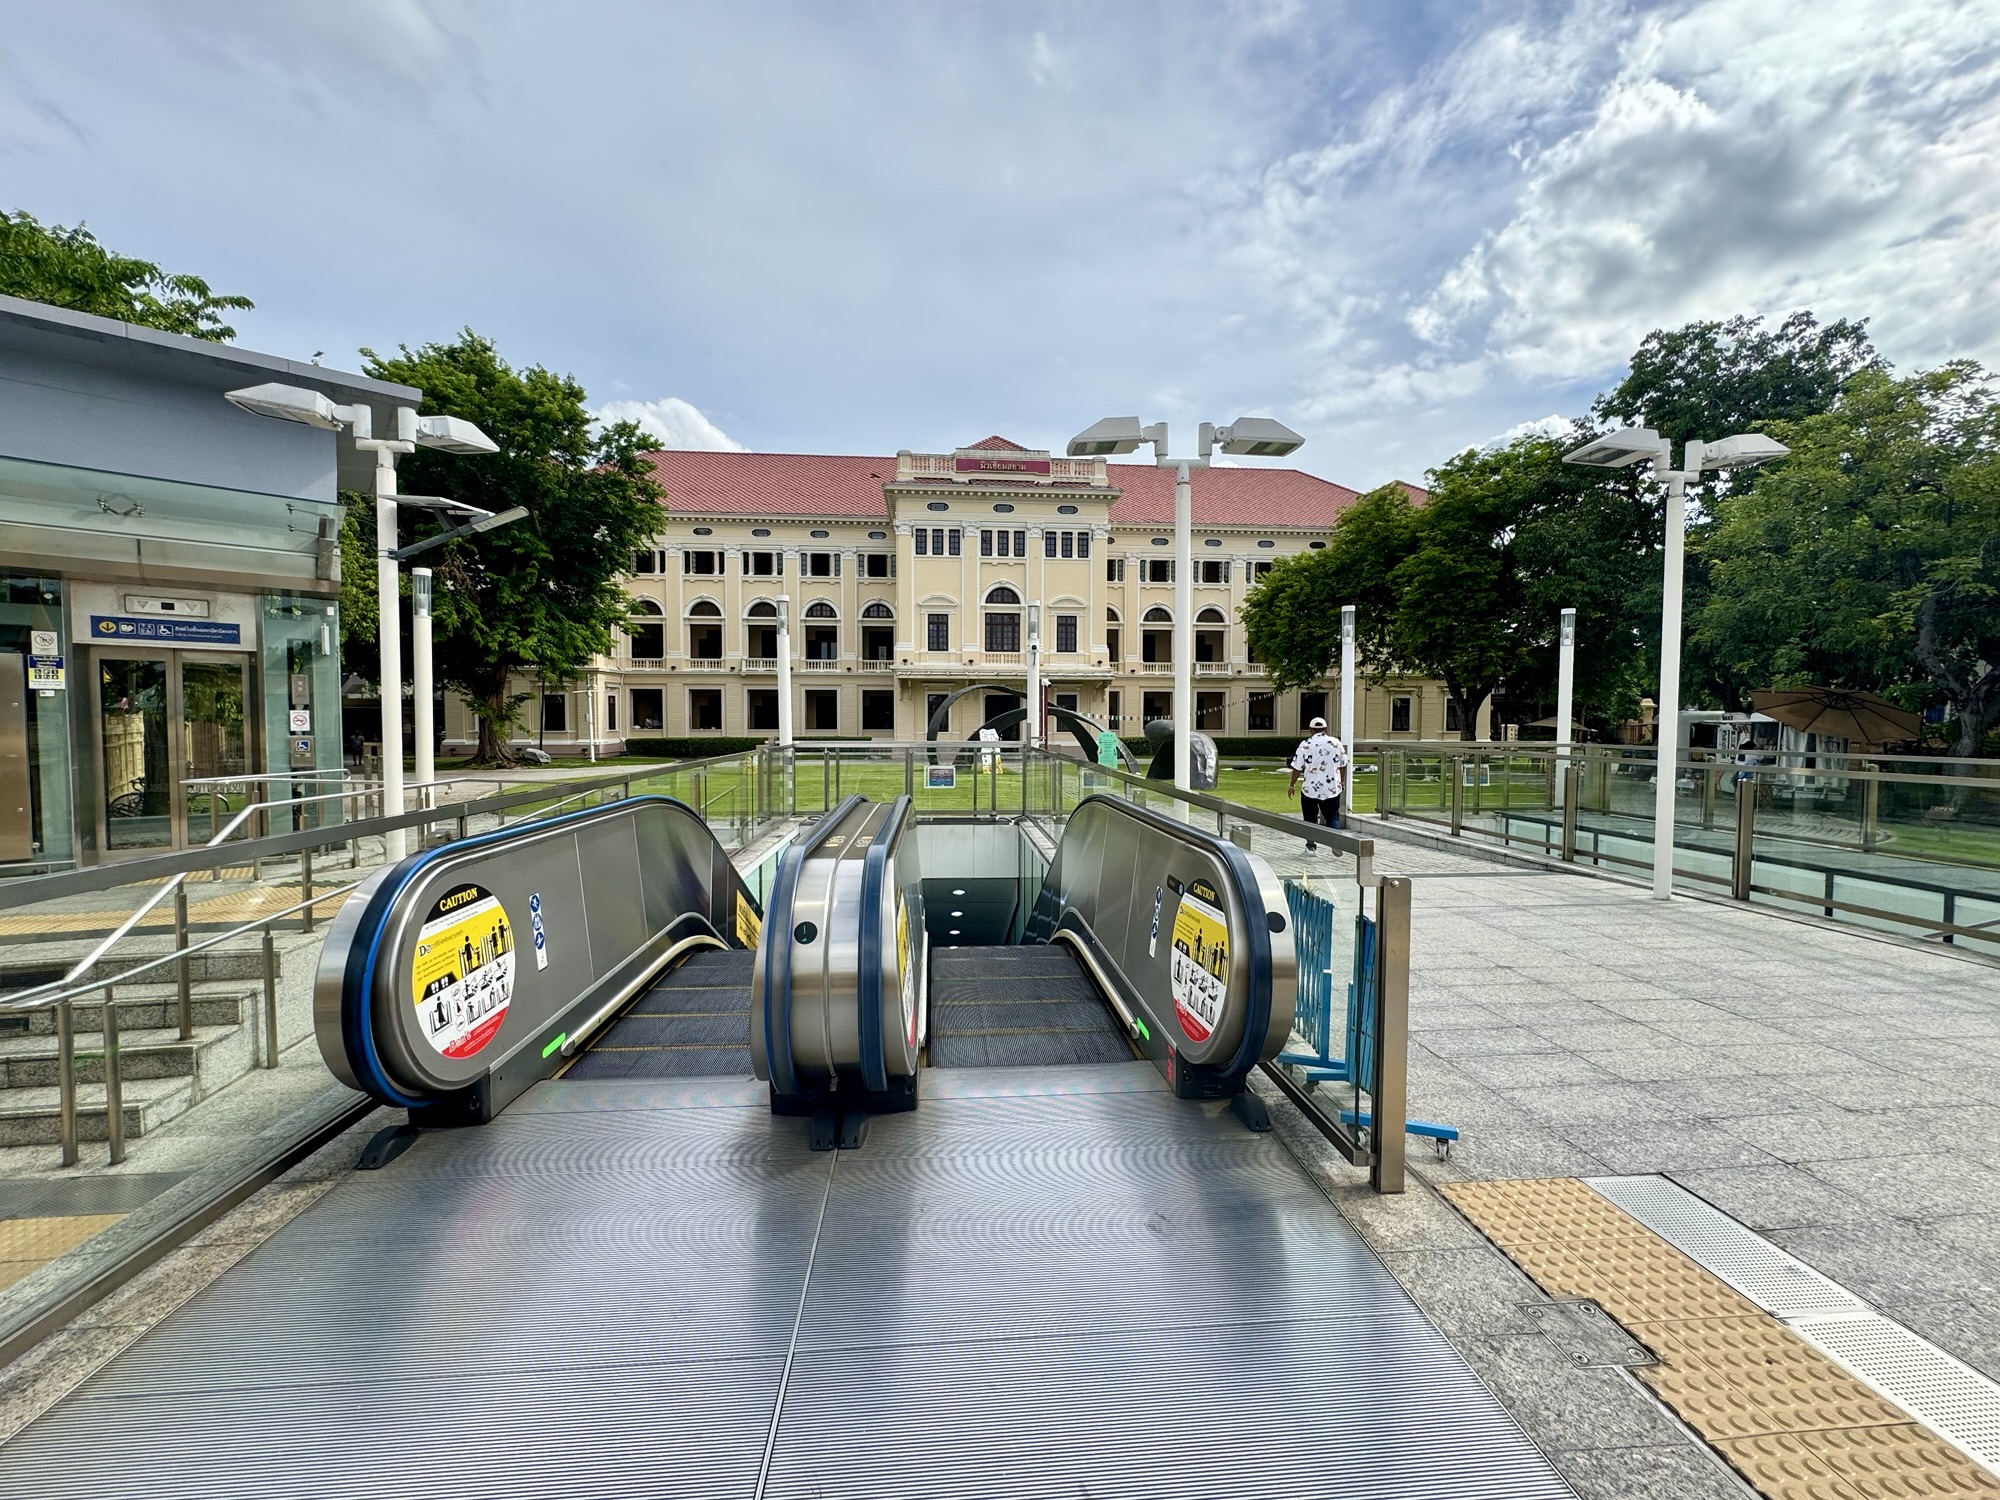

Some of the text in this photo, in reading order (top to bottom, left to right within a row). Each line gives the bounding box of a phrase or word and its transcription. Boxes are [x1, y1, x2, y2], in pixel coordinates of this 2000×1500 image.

[980, 460, 1027, 471] มิวเซียมสยาม
[439, 887, 479, 912] CAUTION
[1193, 882, 1216, 902] CAUTION
[418, 944, 432, 958] Do
[448, 1030, 472, 1054] Don't
